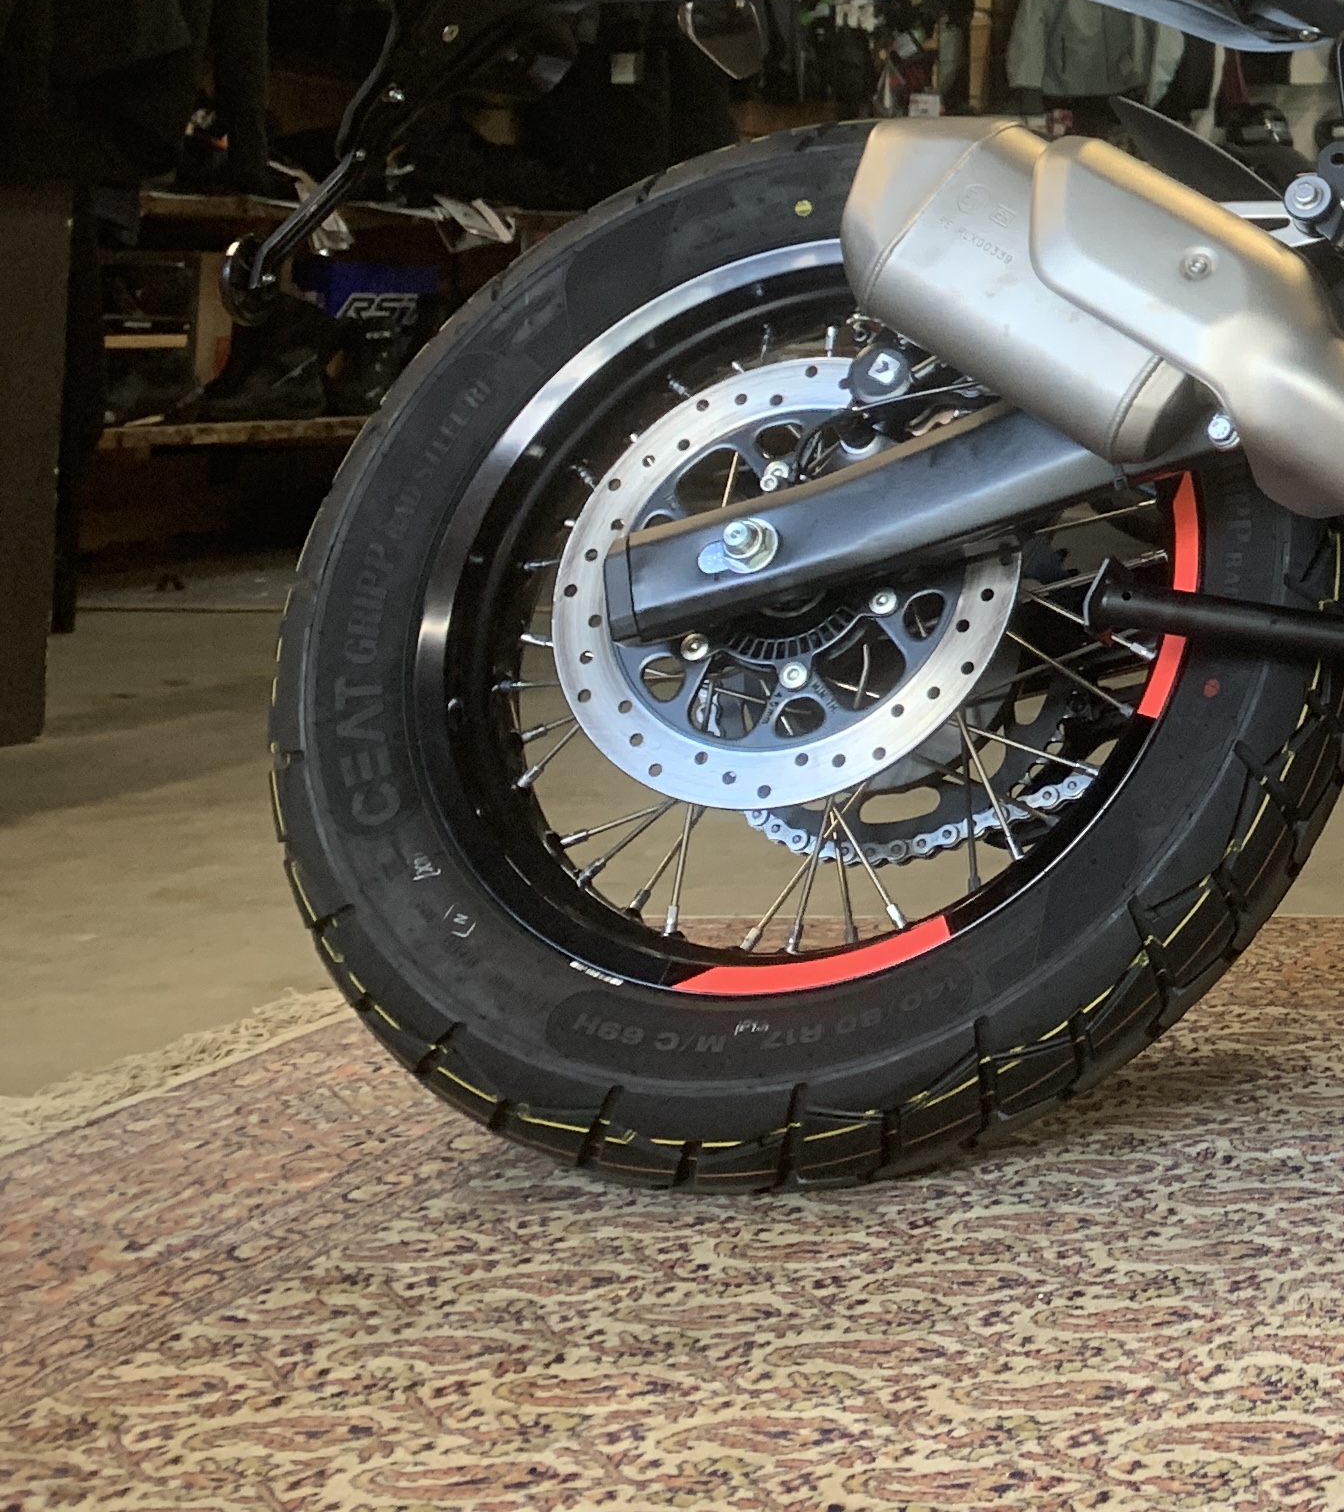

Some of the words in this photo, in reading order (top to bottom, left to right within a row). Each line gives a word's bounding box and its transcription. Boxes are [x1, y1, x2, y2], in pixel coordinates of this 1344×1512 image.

[344, 541, 394, 665] GRIPP
[334, 675, 400, 828] CEAT
[571, 1013, 646, 1047] 69H
[653, 1031, 727, 1053] M/C
[758, 1021, 824, 1051] R17
